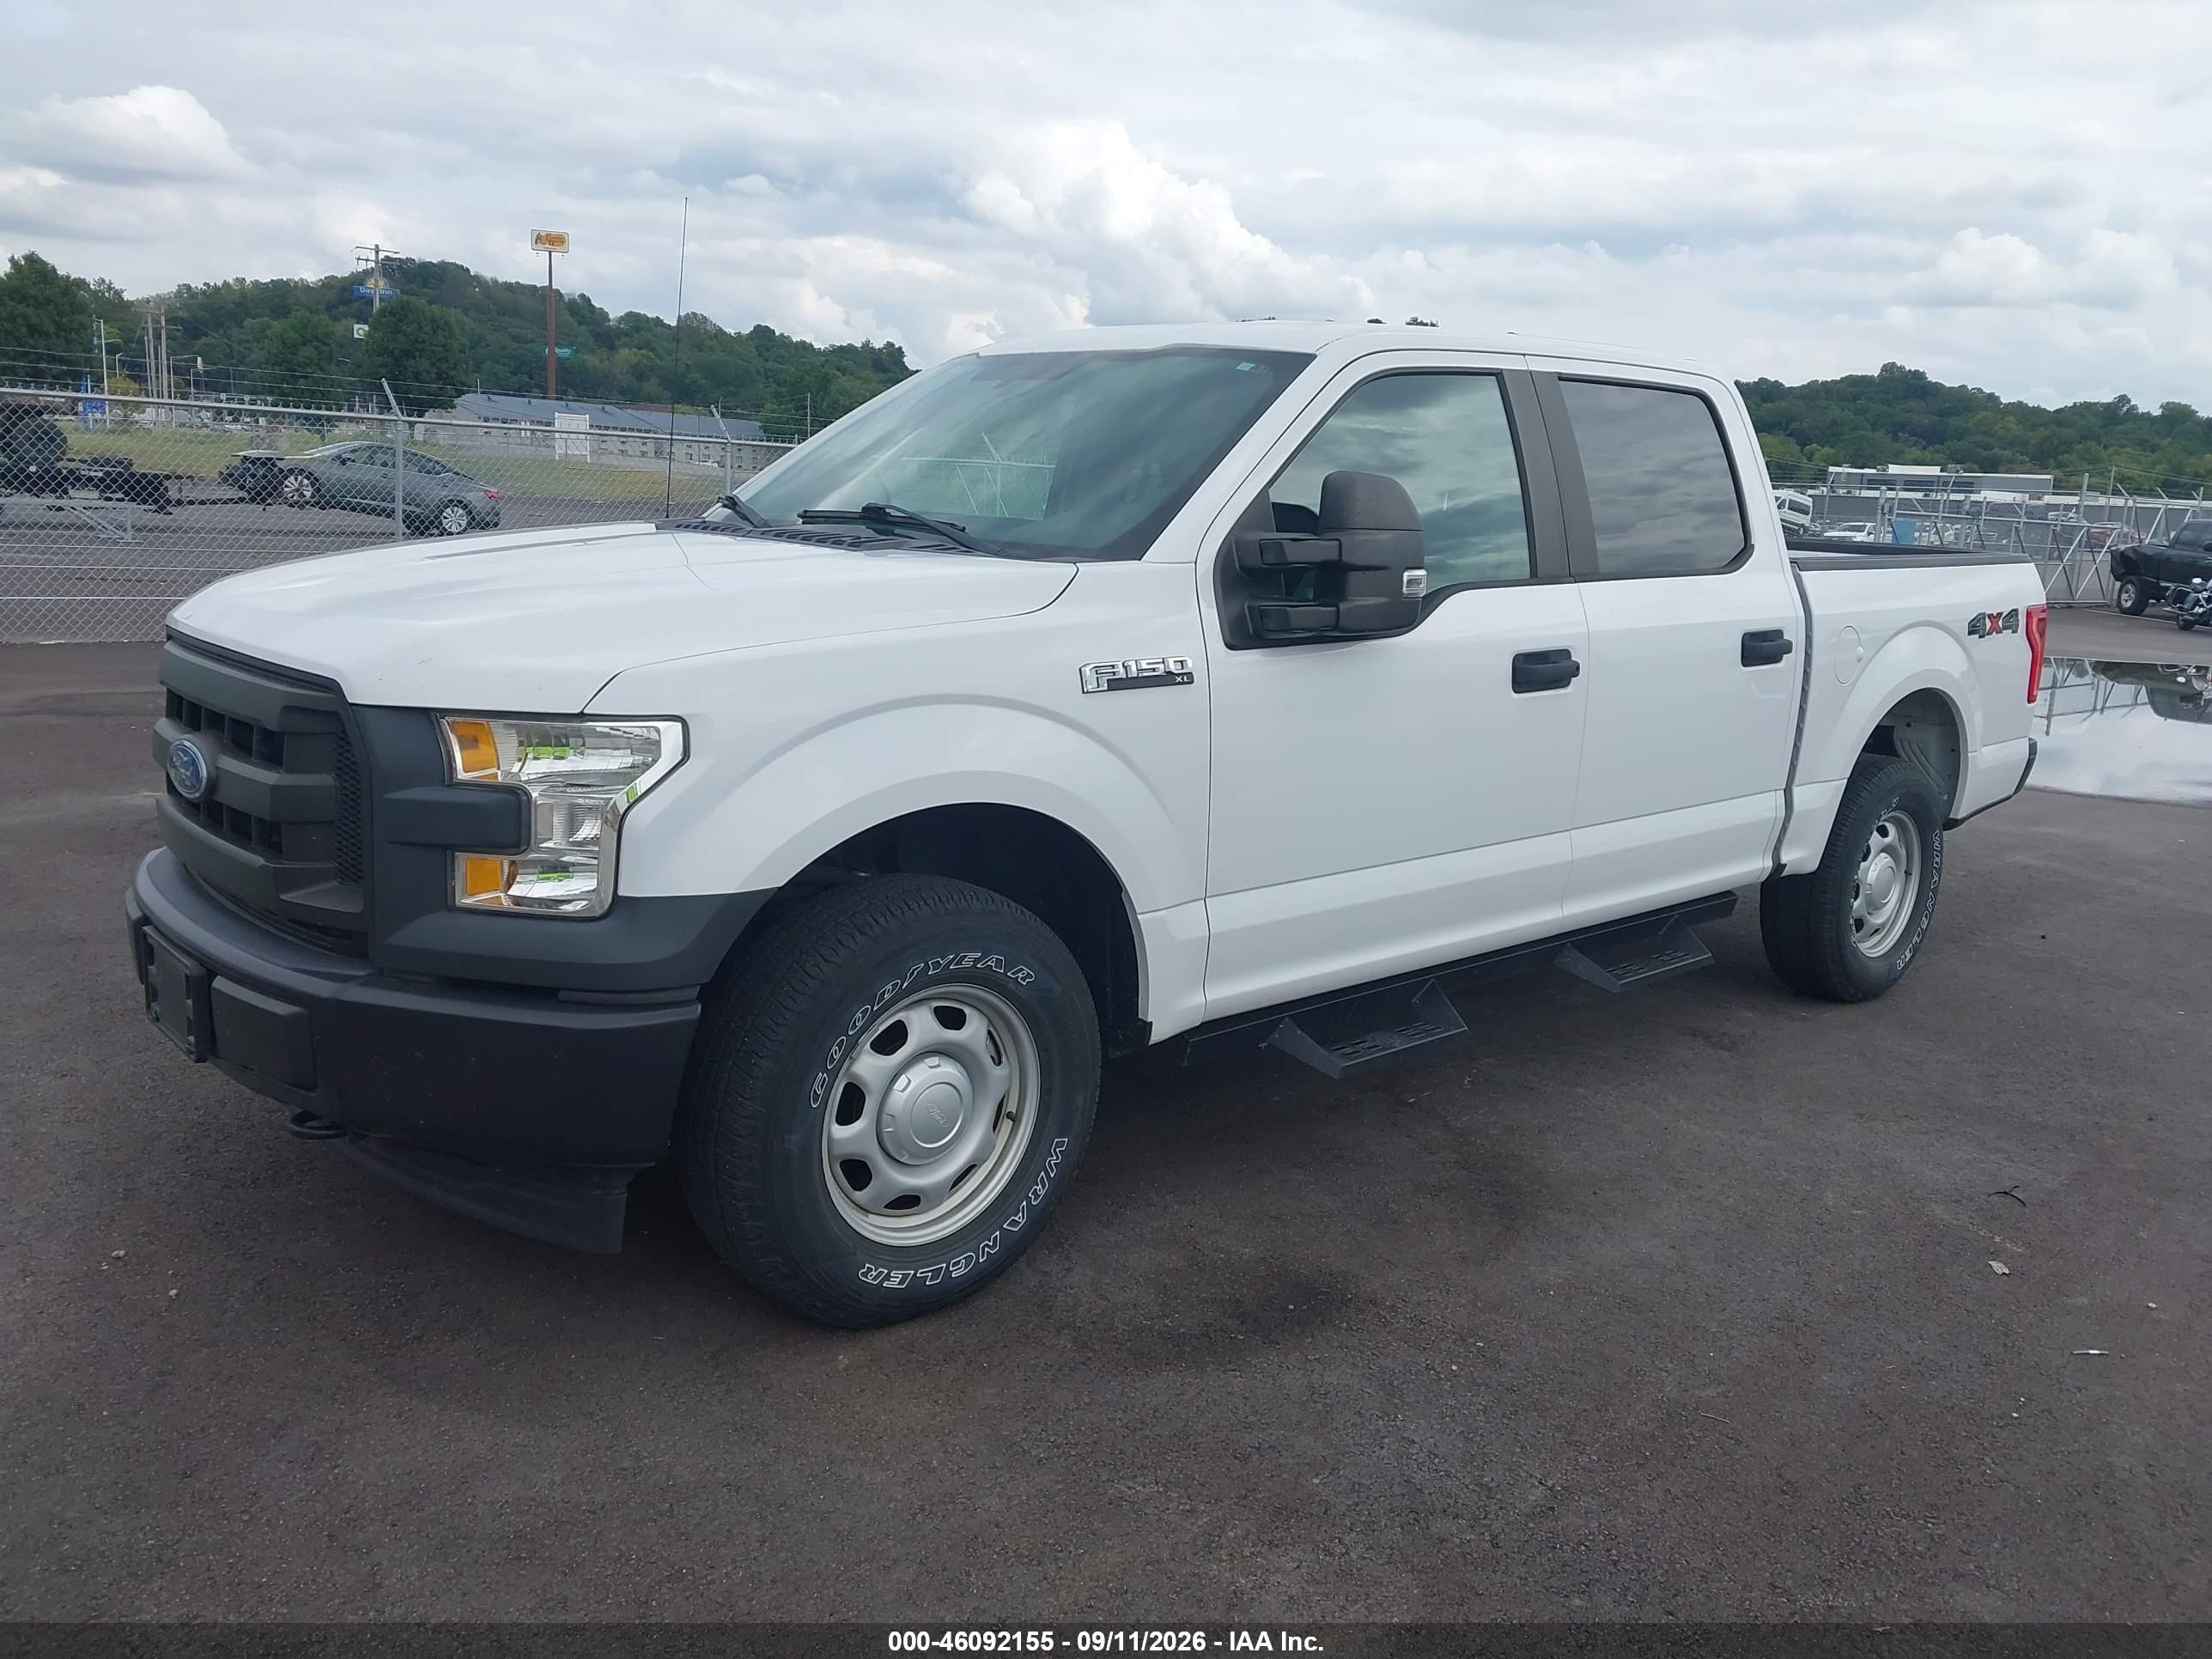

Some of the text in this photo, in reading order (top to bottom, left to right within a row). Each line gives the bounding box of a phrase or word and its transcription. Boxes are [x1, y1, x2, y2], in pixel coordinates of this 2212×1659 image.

[1896, 829, 1942, 970] WRANGLER
[810, 952, 1036, 1108] GOODYEAR
[858, 1138, 1068, 1289] WRANGLER
